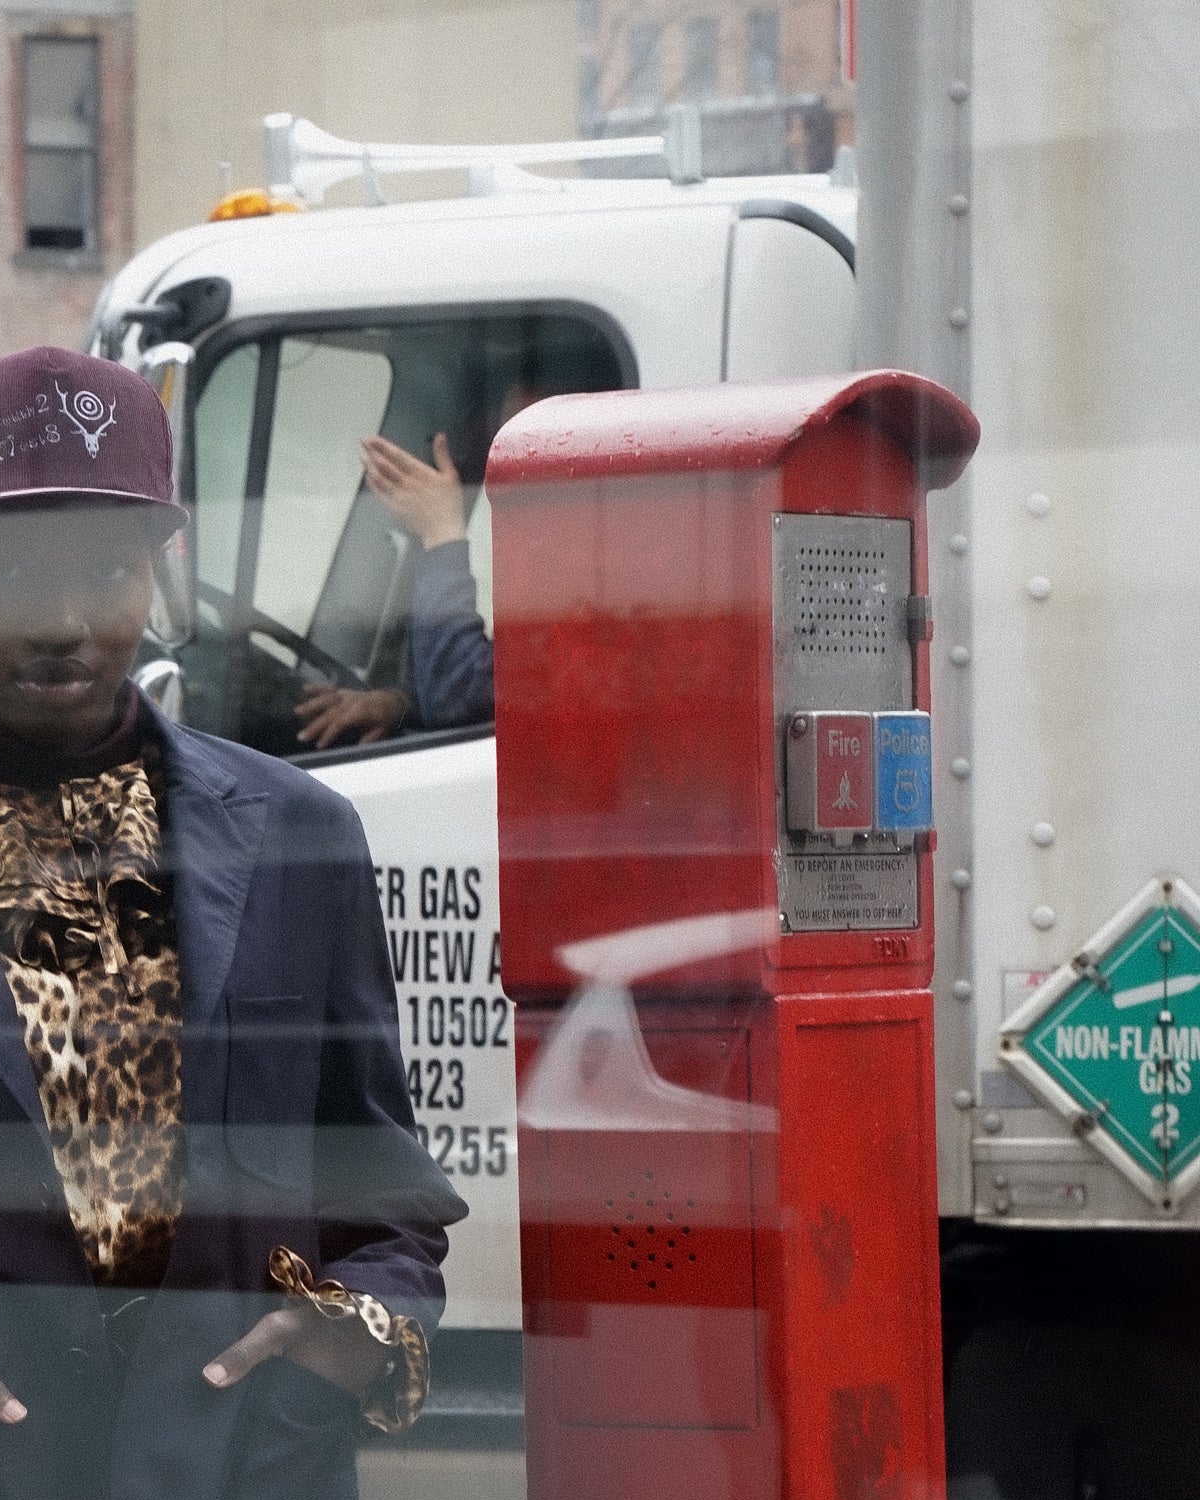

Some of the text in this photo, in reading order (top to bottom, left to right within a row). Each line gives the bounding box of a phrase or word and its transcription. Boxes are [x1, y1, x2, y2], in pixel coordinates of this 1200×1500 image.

[828, 729, 861, 757] Fire
[880, 728, 929, 756] Police
[793, 860, 805, 873] TO
[807, 860, 837, 872] REPORT
[840, 859, 852, 871] AN
[420, 866, 480, 920] GAS
[389, 930, 475, 984] VIEW
[407, 996, 508, 1047] 10502
[407, 1058, 464, 1110] 423
[1140, 1060, 1191, 1095] GAS
[1150, 1103, 1180, 1140] 2
